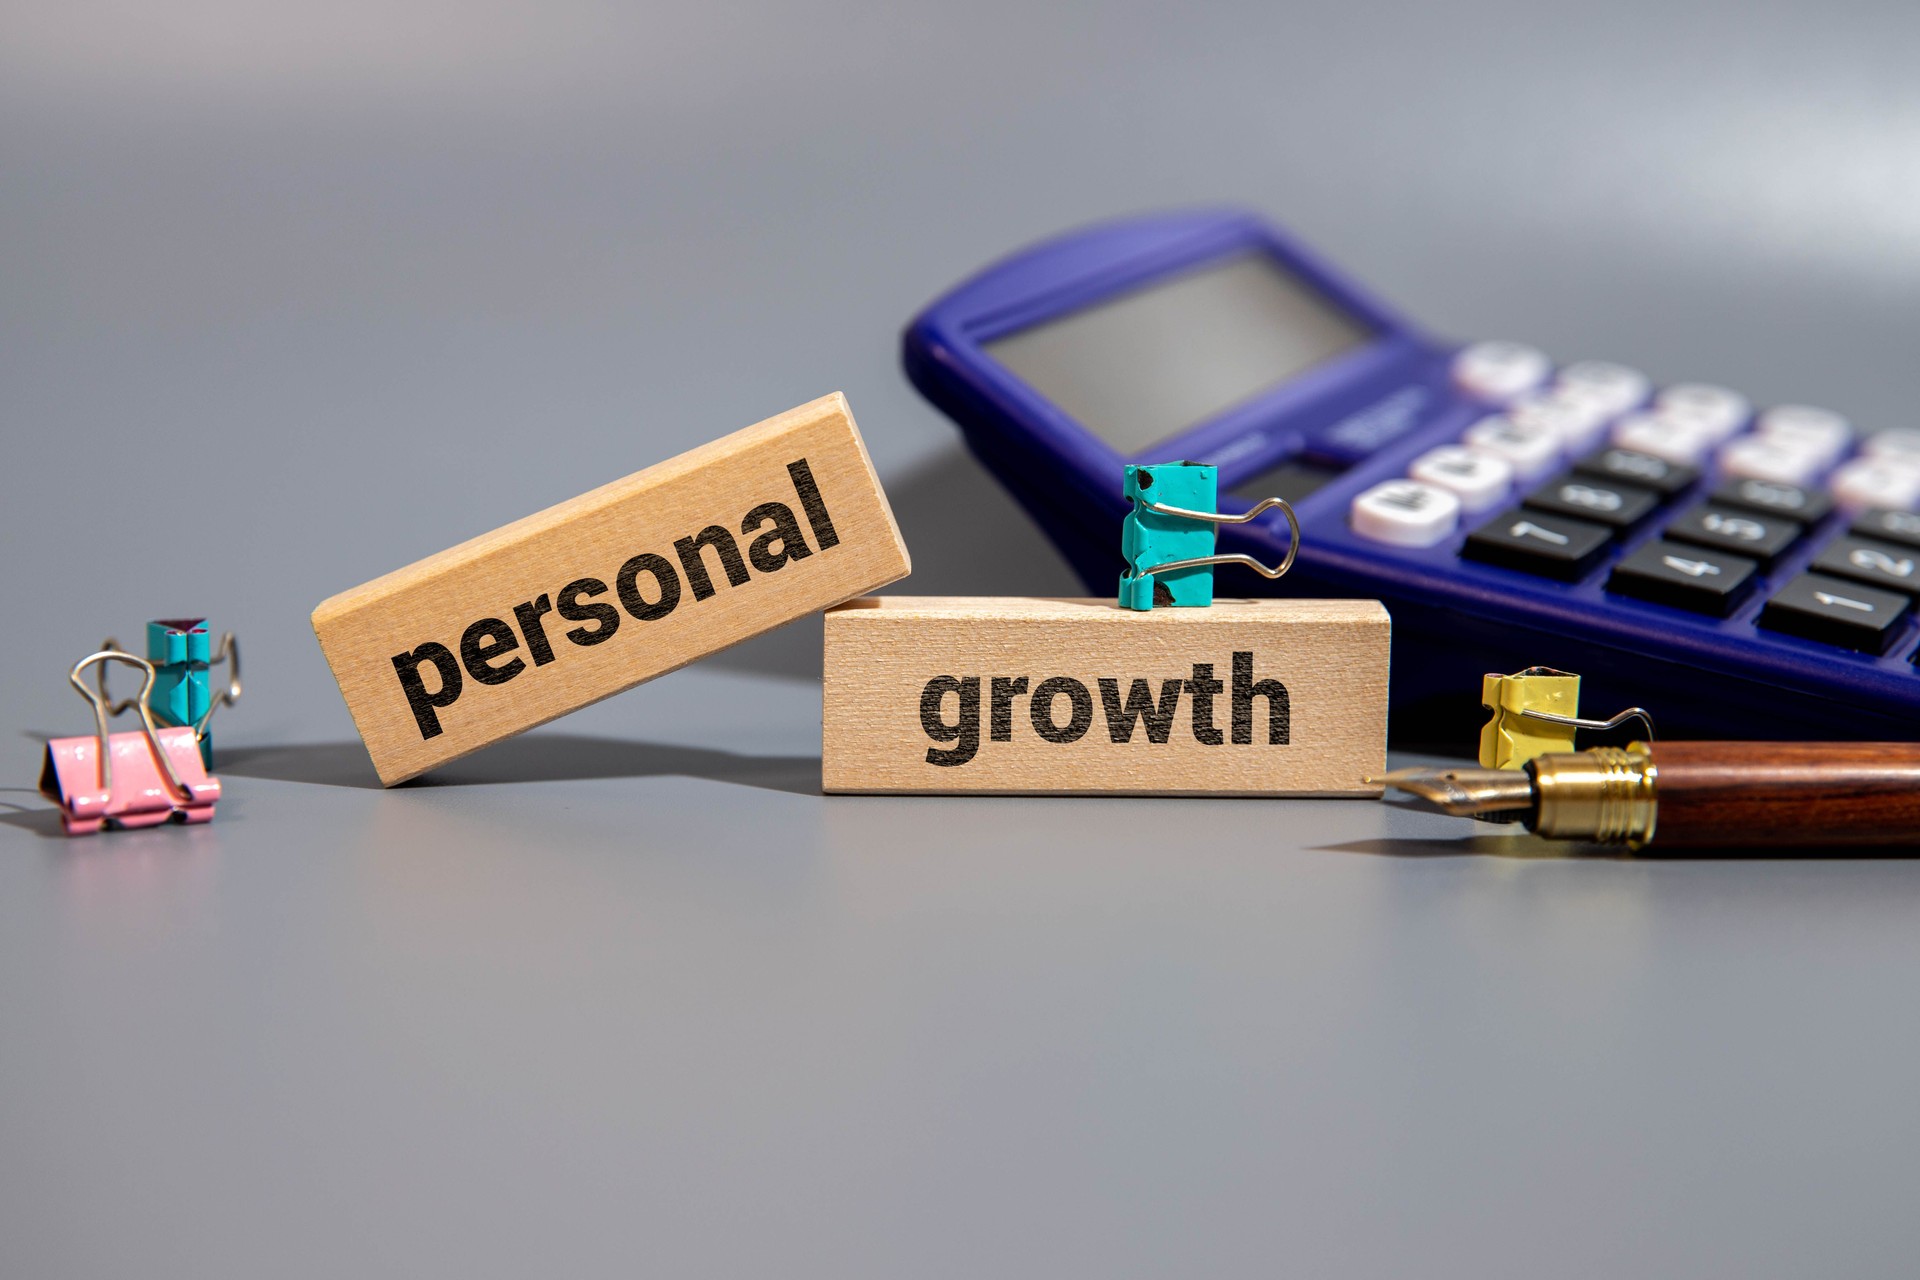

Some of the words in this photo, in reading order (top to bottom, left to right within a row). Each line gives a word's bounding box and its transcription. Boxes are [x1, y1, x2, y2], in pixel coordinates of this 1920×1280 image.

[1509, 520, 1570, 546] 7
[1702, 513, 1766, 541] 5
[1663, 554, 1721, 577] 4
[1849, 549, 1915, 577] 2
[390, 457, 841, 741] personal
[1814, 590, 1874, 612] 1
[919, 651, 1291, 767] growth
